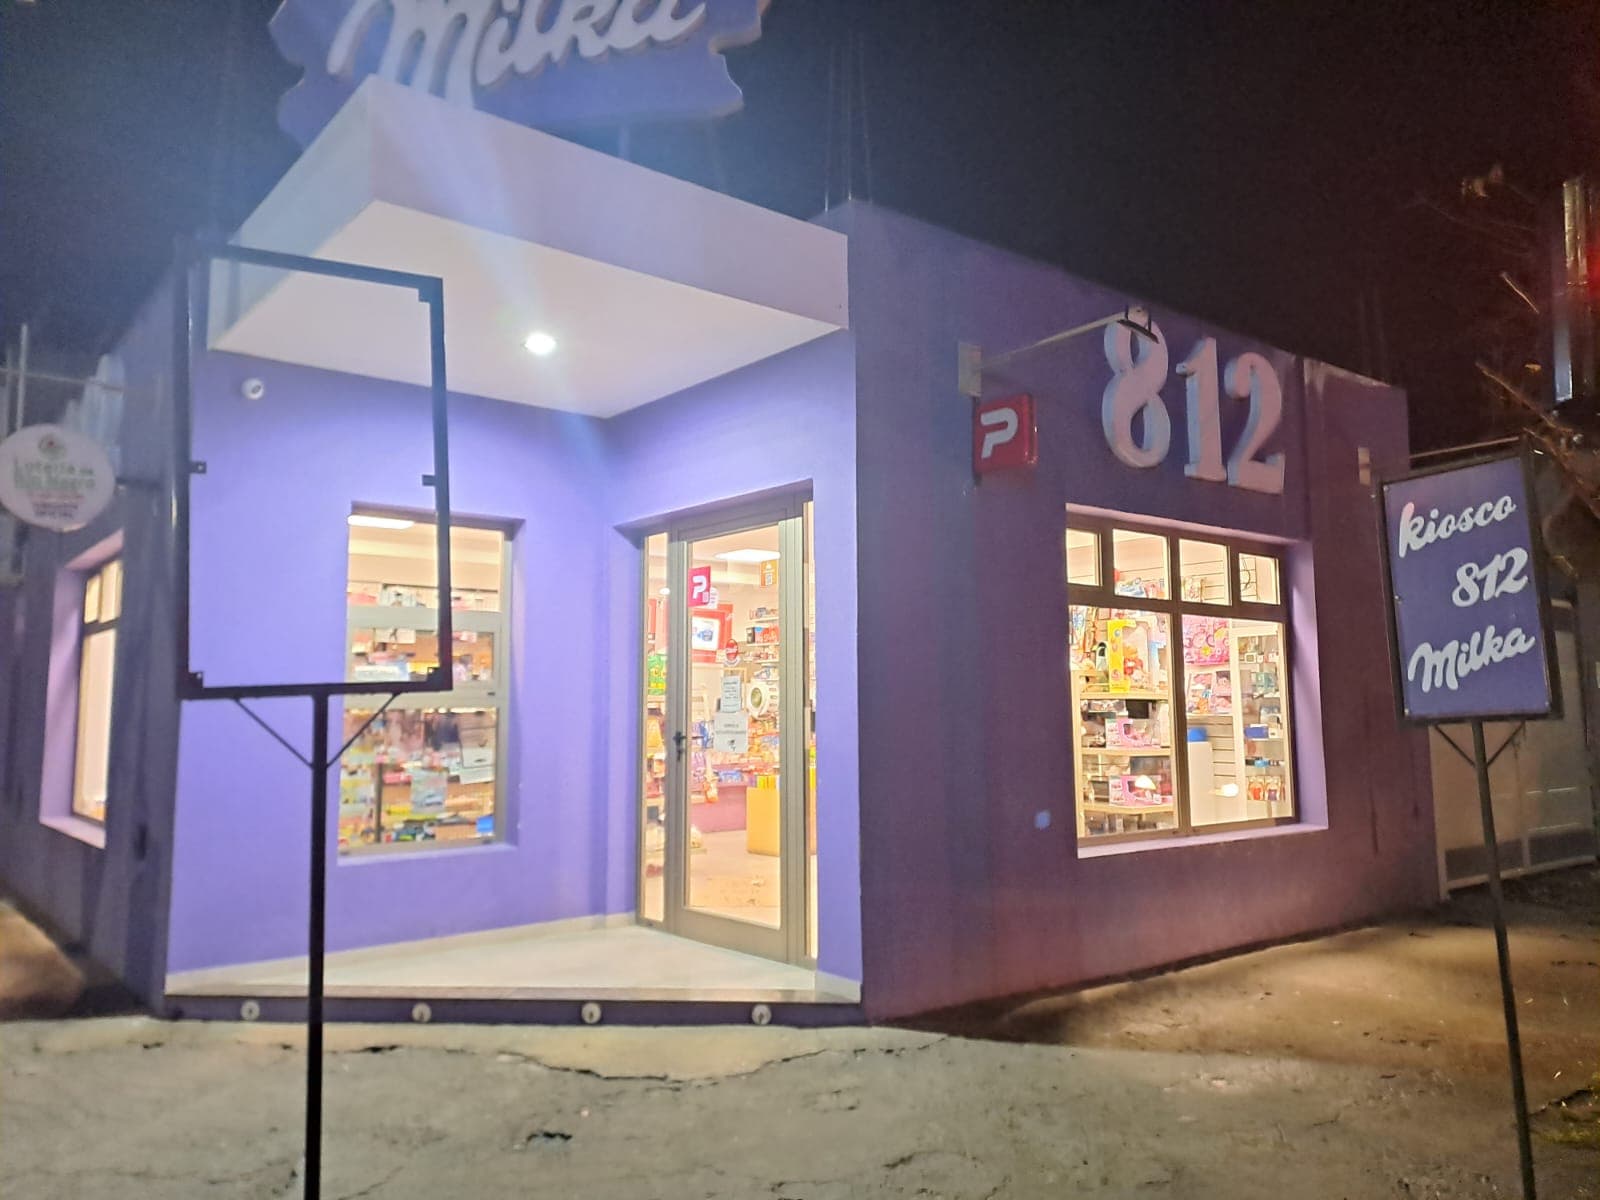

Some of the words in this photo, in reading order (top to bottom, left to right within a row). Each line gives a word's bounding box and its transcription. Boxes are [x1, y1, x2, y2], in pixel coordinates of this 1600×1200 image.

[1102, 306, 1285, 494] 812
[1399, 495, 1517, 558] kiosco
[1452, 547, 1528, 607] 812
[1407, 625, 1535, 693] Milka
